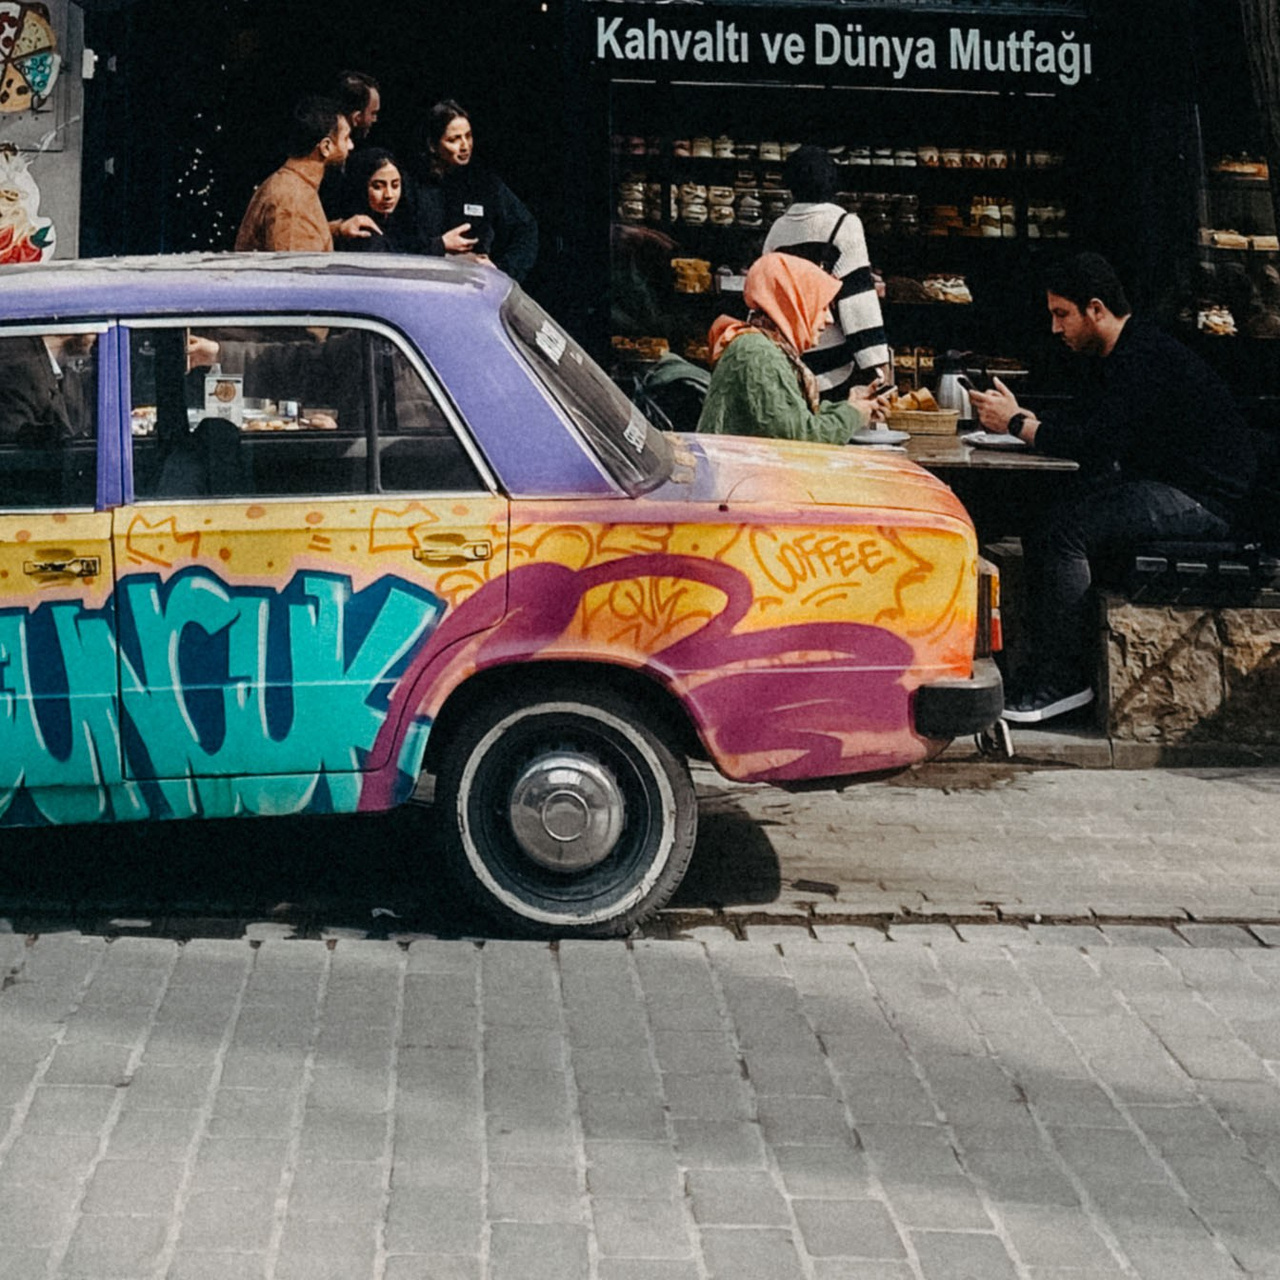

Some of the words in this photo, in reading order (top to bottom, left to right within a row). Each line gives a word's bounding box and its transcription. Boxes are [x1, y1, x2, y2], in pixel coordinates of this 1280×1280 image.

[596, 17, 749, 62] Kahvaltı
[761, 32, 805, 64] ve
[815, 23, 937, 80] Dünya
[950, 28, 1093, 85] Mutfağı
[750, 525, 897, 594] COFFEE
